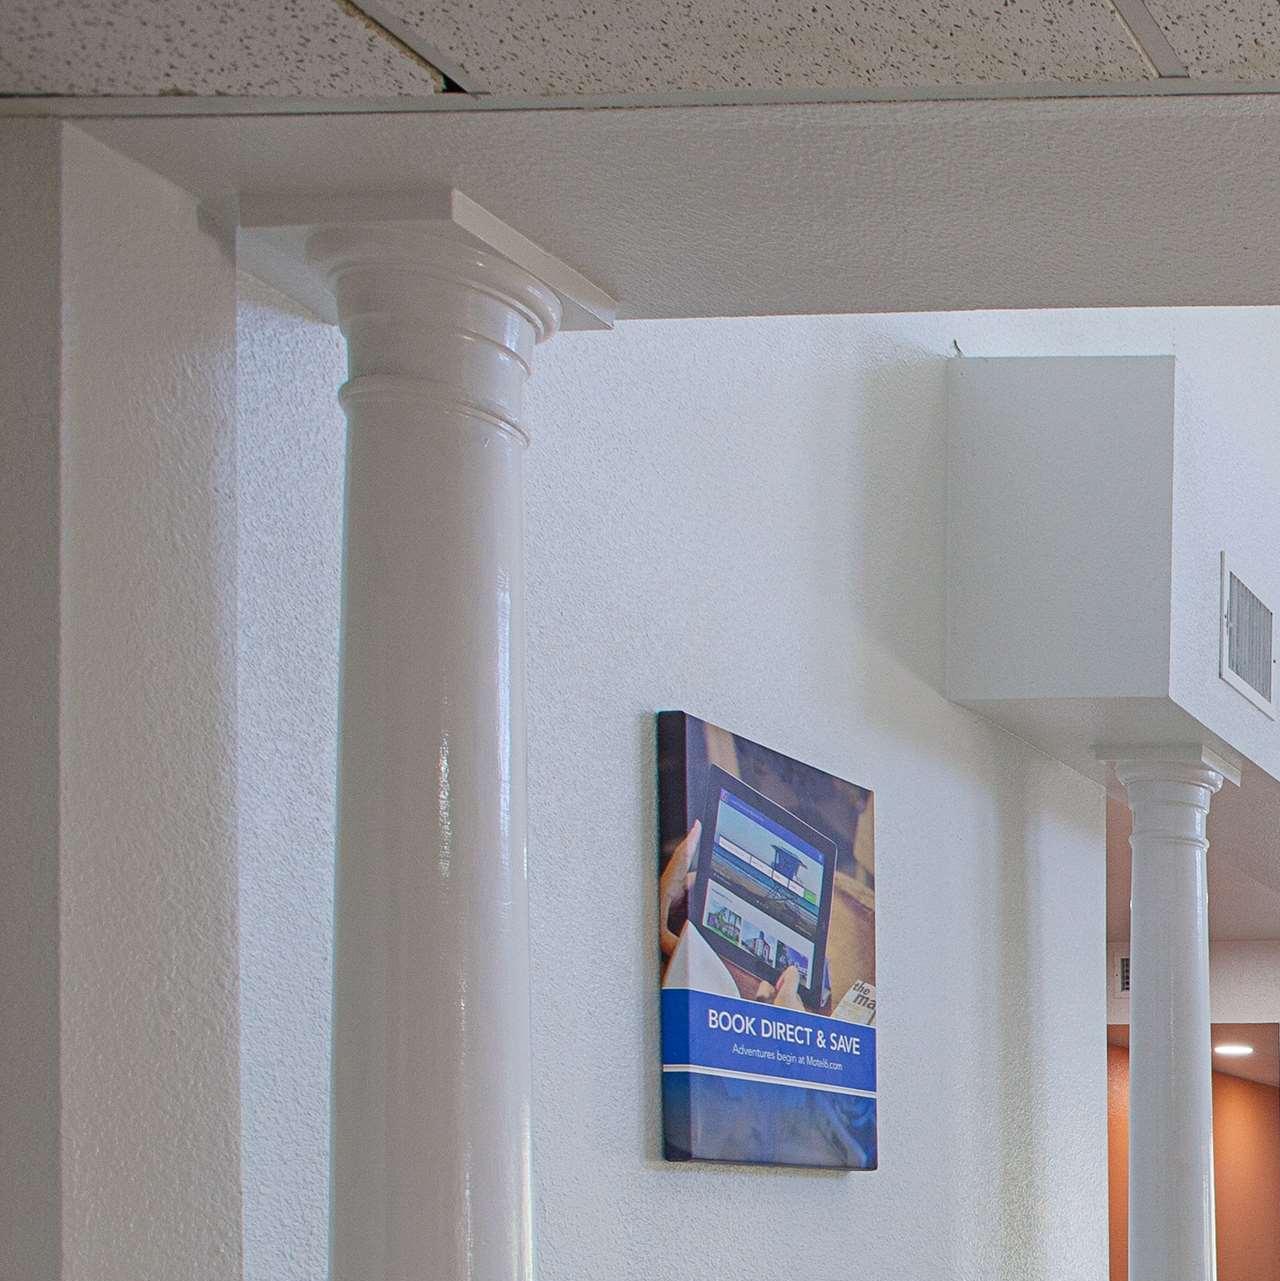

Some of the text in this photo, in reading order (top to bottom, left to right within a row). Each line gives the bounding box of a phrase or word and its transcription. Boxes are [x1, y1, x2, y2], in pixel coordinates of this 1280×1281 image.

[852, 981, 871, 996] the
[708, 1008, 861, 1055] BOOK DIRECT & SAVE
[731, 1042, 843, 1071] Adventures begin at Motel6.com
